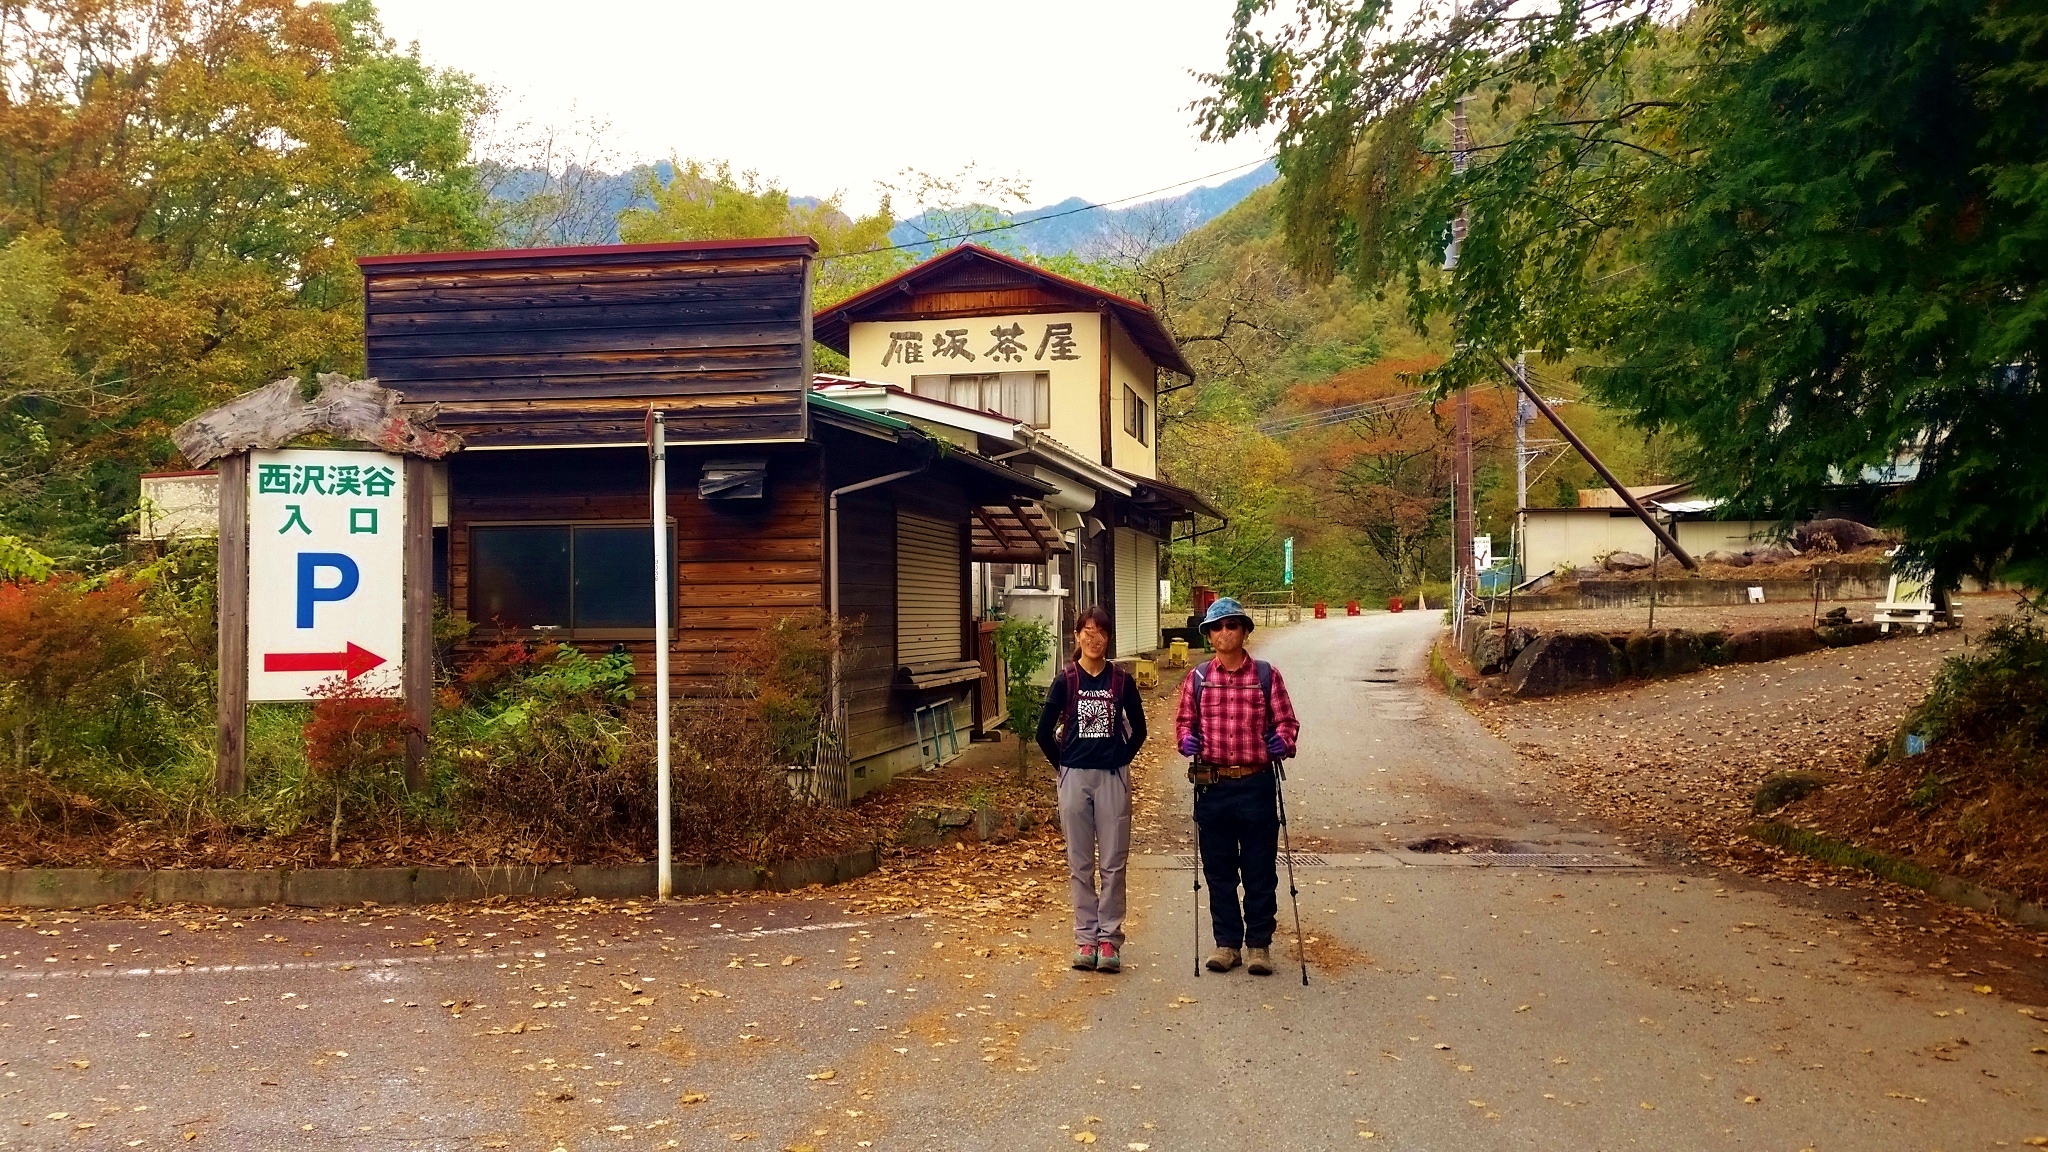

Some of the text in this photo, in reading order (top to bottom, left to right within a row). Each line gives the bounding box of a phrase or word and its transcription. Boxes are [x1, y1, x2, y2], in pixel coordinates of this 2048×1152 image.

[881, 321, 1082, 367] 雁坂茶屋
[258, 463, 396, 497] 西沢渓谷
[296, 552, 360, 629] P
